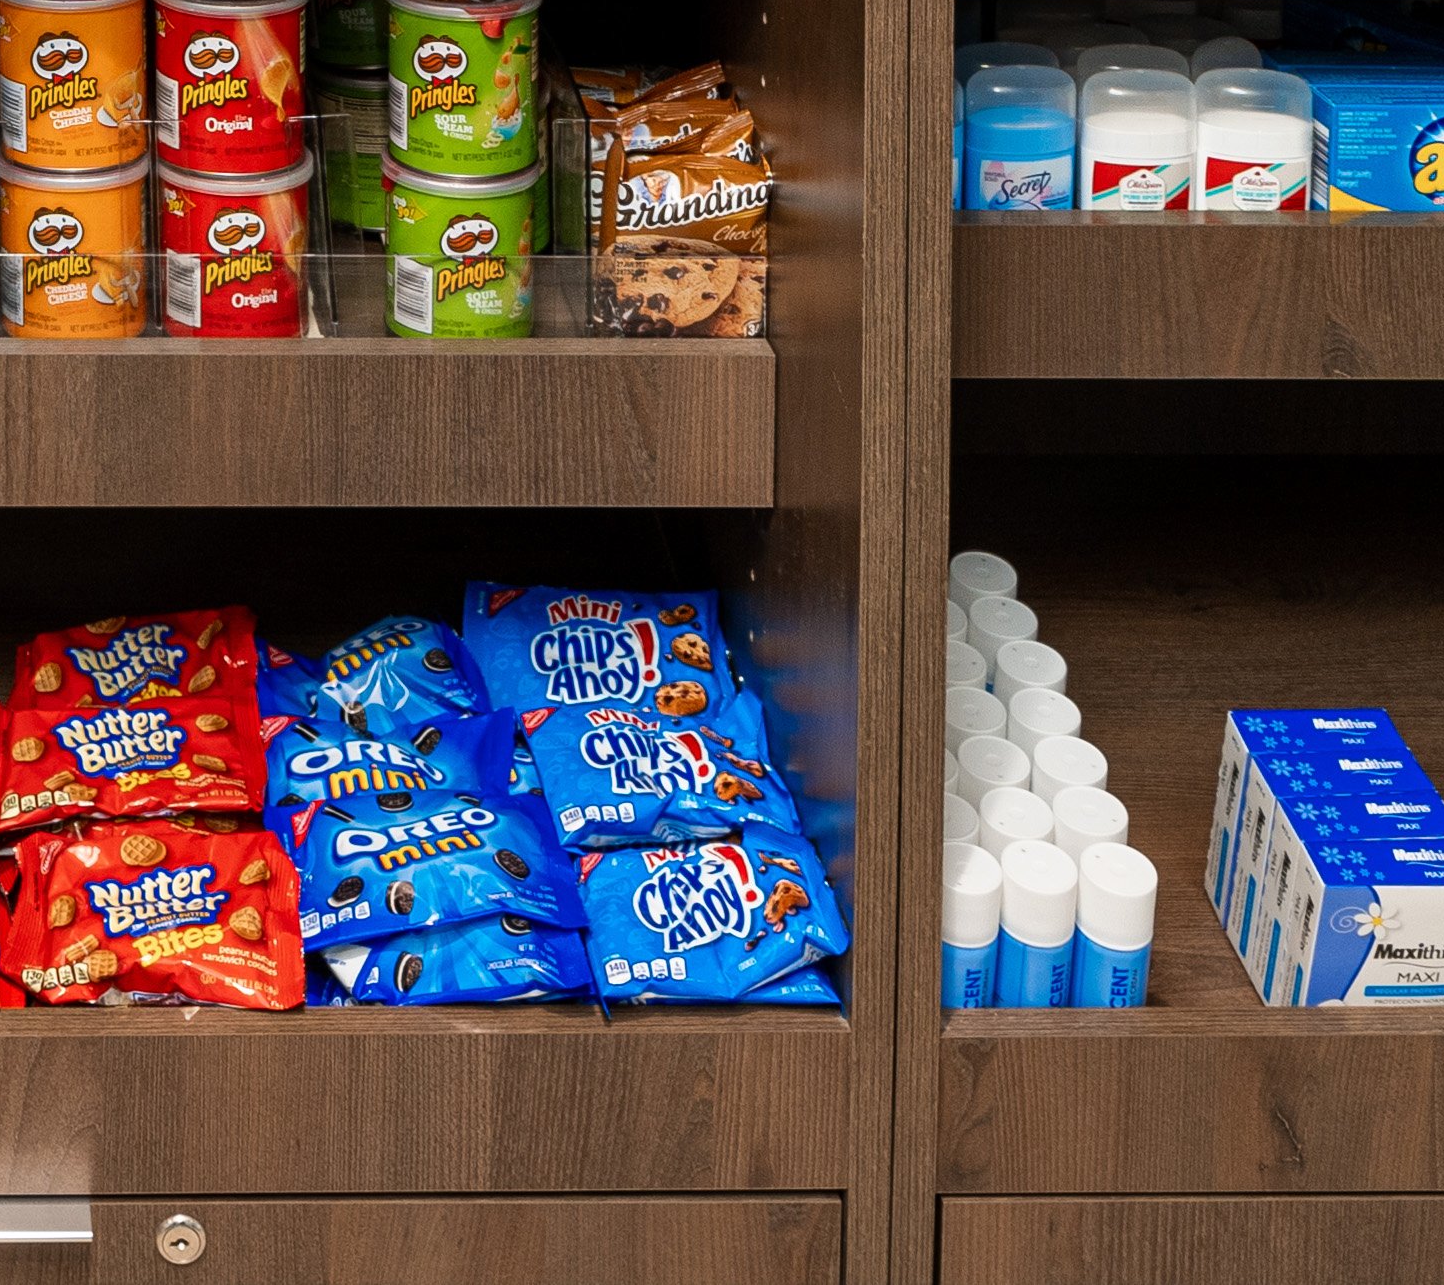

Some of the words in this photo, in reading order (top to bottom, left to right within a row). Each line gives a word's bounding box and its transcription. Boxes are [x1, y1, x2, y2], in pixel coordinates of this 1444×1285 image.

[336, 805, 497, 854] OREO
[380, 830, 482, 872] mini
[91, 867, 213, 911] Nutter
[104, 891, 225, 932] Butter
[133, 925, 223, 967] Bites
[1397, 972, 1440, 982] MAXI
